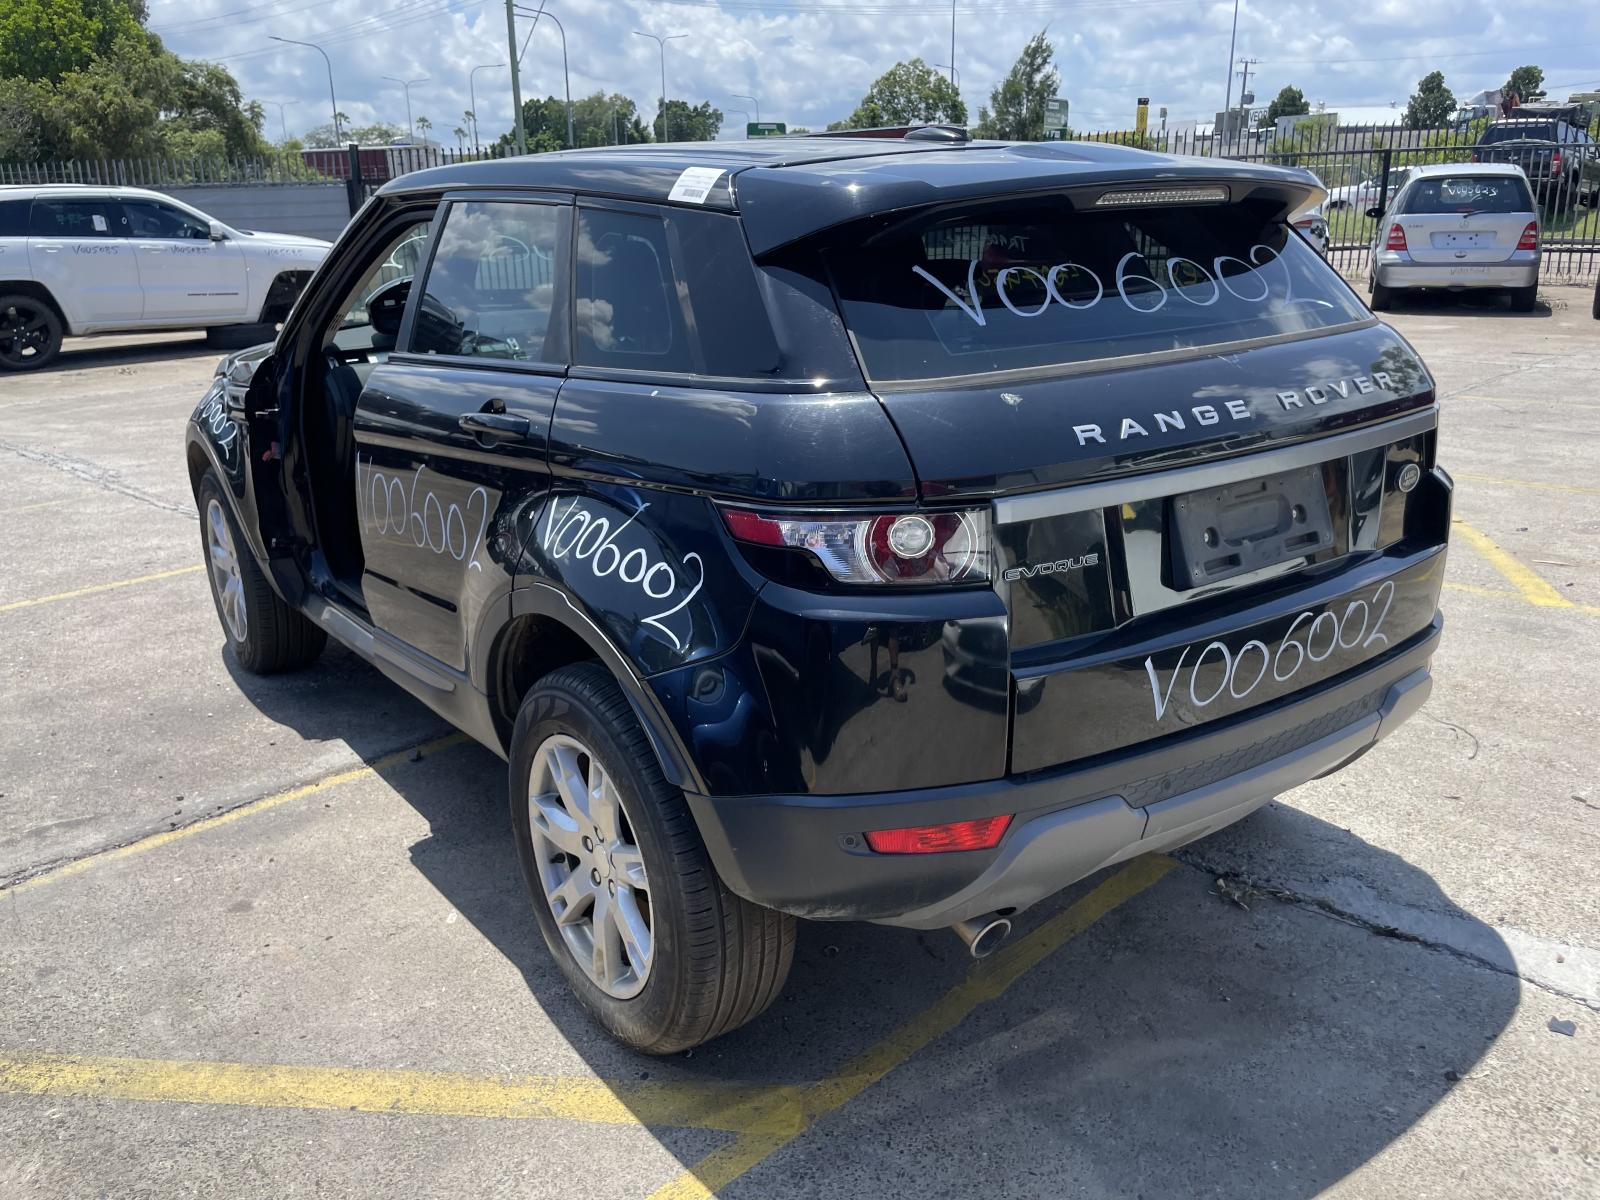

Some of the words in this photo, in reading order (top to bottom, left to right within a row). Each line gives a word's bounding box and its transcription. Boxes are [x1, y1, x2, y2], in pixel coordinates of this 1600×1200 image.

[911, 244, 1334, 326] V006002
[1072, 399, 1251, 446] RANGE
[1277, 371, 1395, 411] ROVER
[355, 450, 488, 573] V006002
[543, 495, 704, 650] V006002
[1003, 553, 1099, 581] EVOQUE
[1144, 580, 1396, 721] V006002
